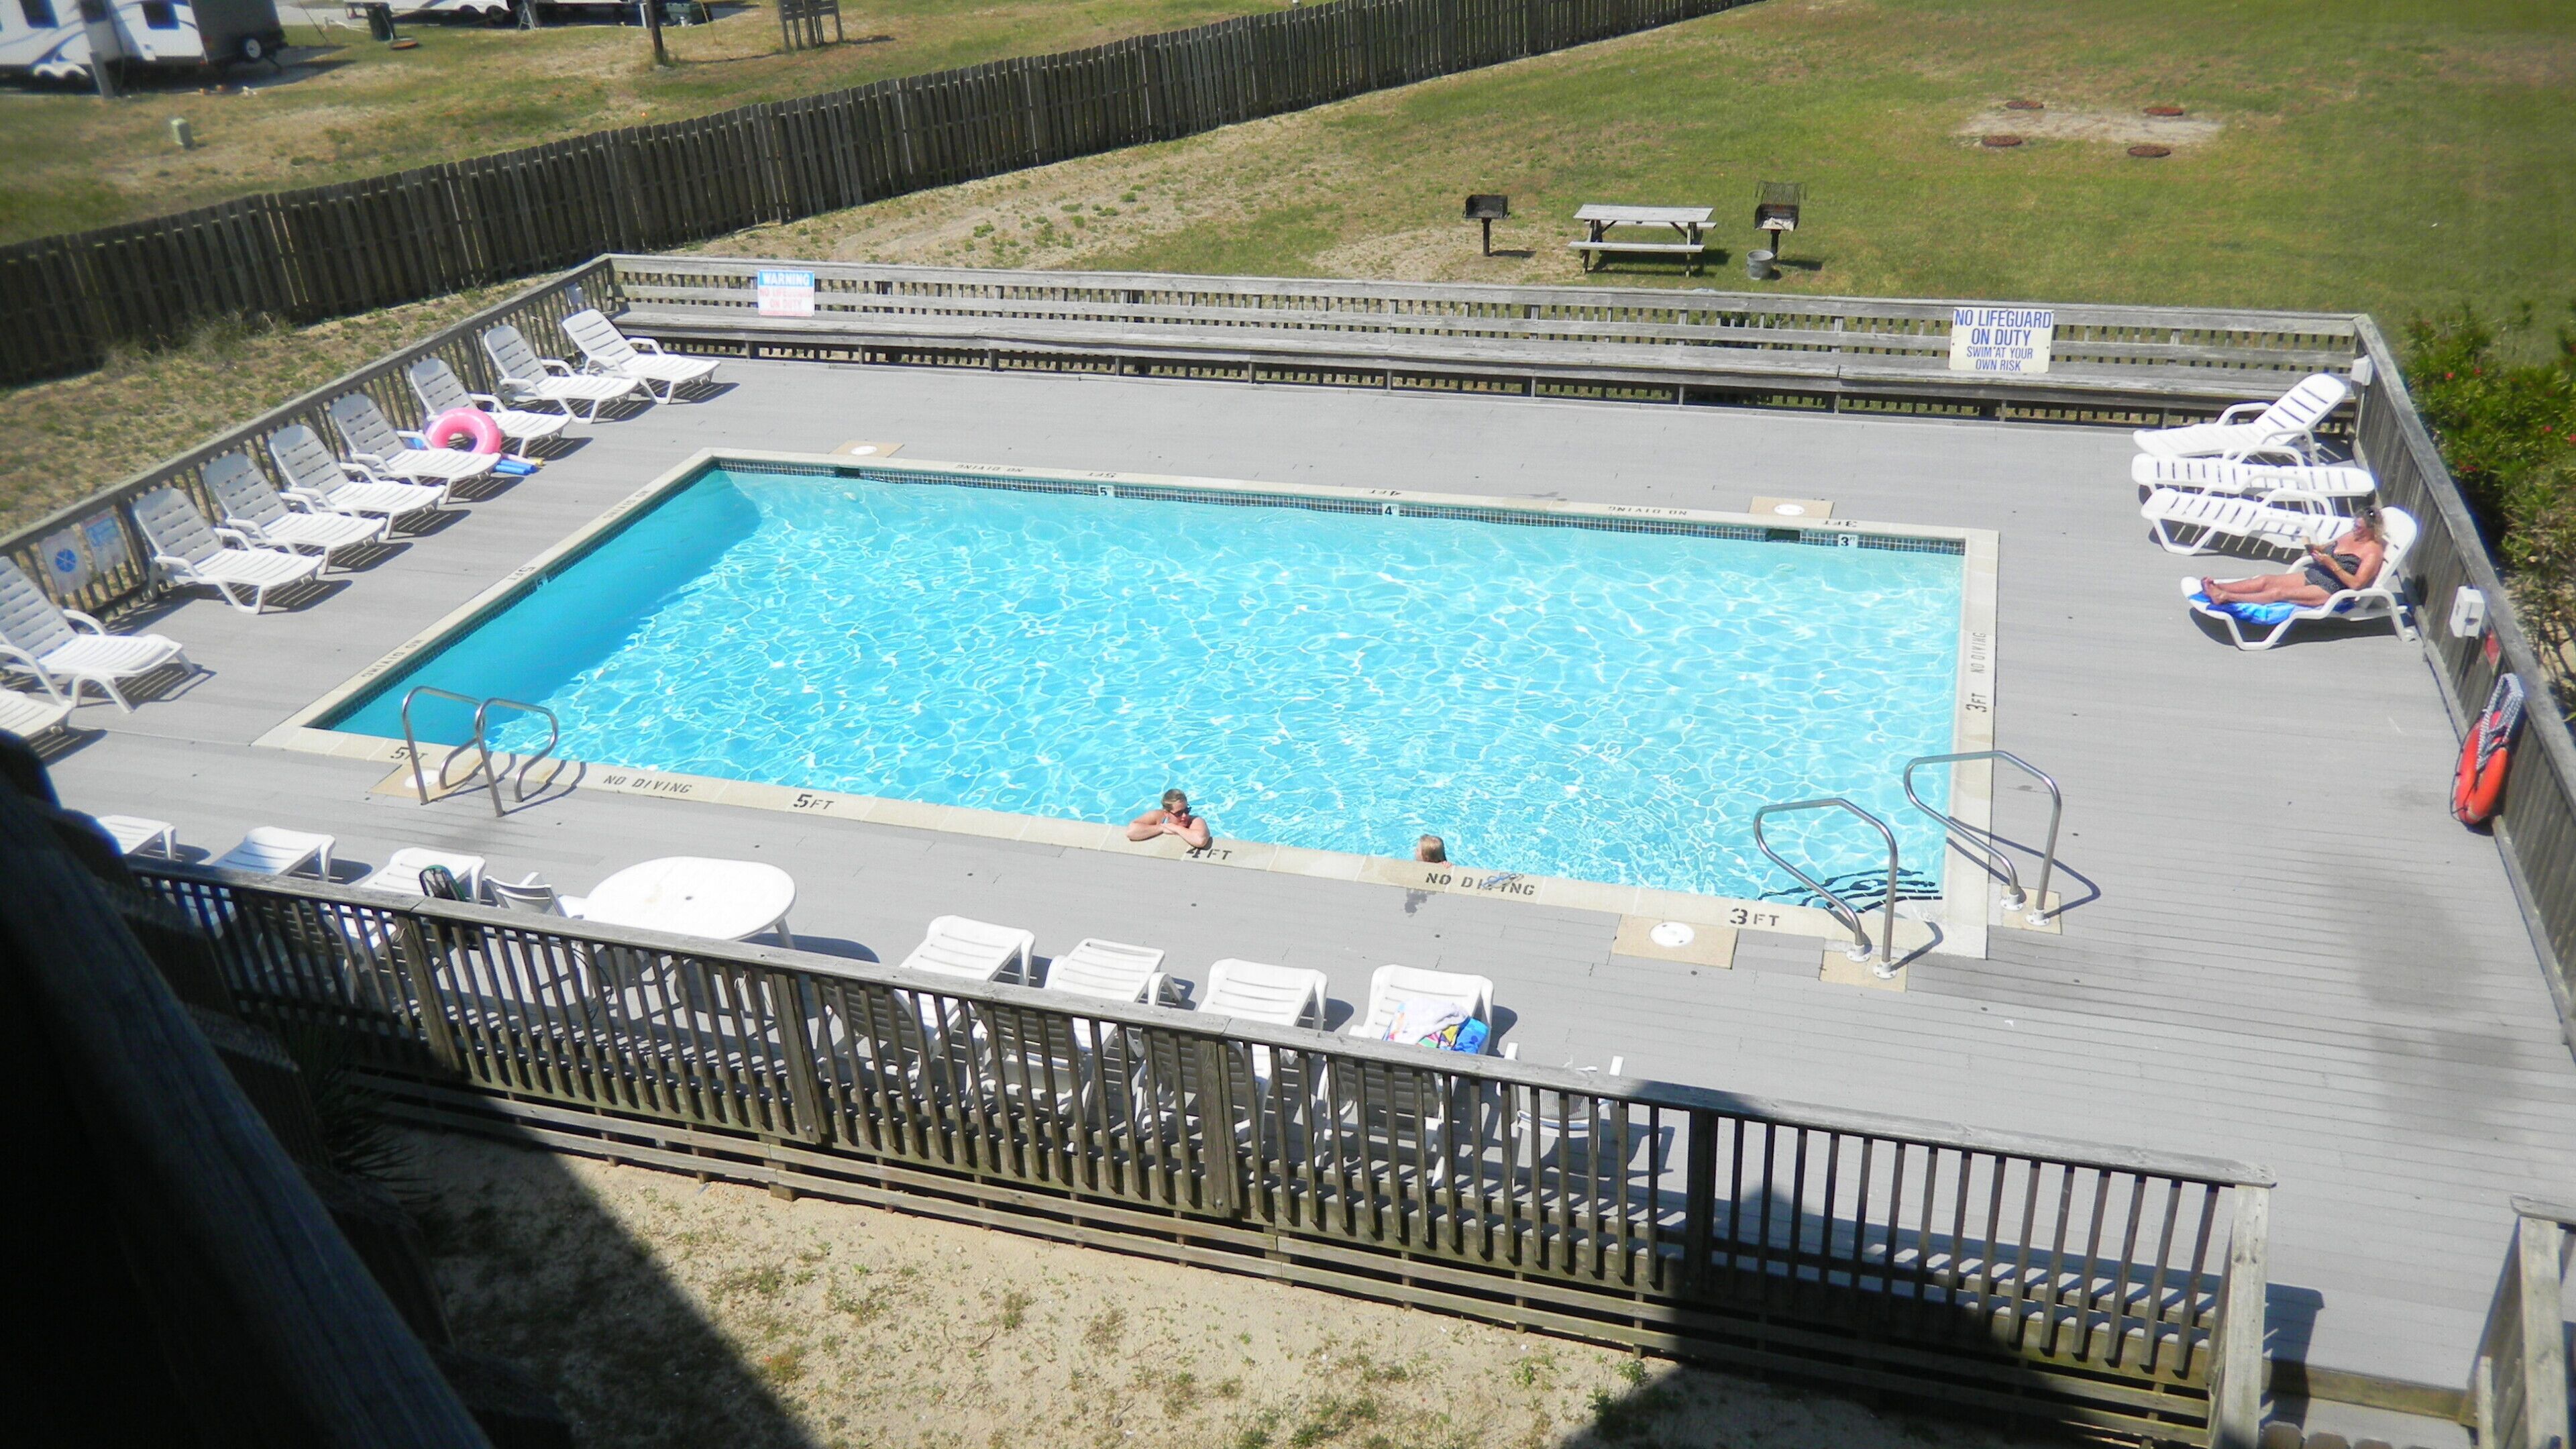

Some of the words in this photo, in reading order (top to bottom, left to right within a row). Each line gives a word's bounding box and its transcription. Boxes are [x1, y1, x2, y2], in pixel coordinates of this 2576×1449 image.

[762, 272, 810, 286] WARNING
[1955, 309, 1973, 326] NO
[1978, 310, 2052, 328] LIFEGUARD
[1972, 328, 1990, 345] ON
[1995, 329, 2031, 346] DUTY
[1967, 346, 1992, 358] SWIM
[1995, 347, 2006, 358] AT
[2010, 347, 2033, 359] YOUR
[1976, 359, 1997, 370] OWN
[2000, 360, 2021, 371] RISK
[1971, 632, 1986, 661] DIVING
[1966, 692, 1987, 712] 3FT
[603, 775, 627, 785] NO
[632, 777, 692, 794] DIVING
[793, 793, 835, 810] 5FT
[1426, 873, 1452, 885] NO
[1460, 876, 1535, 896] DIING
[1730, 908, 1780, 926] 3FT
